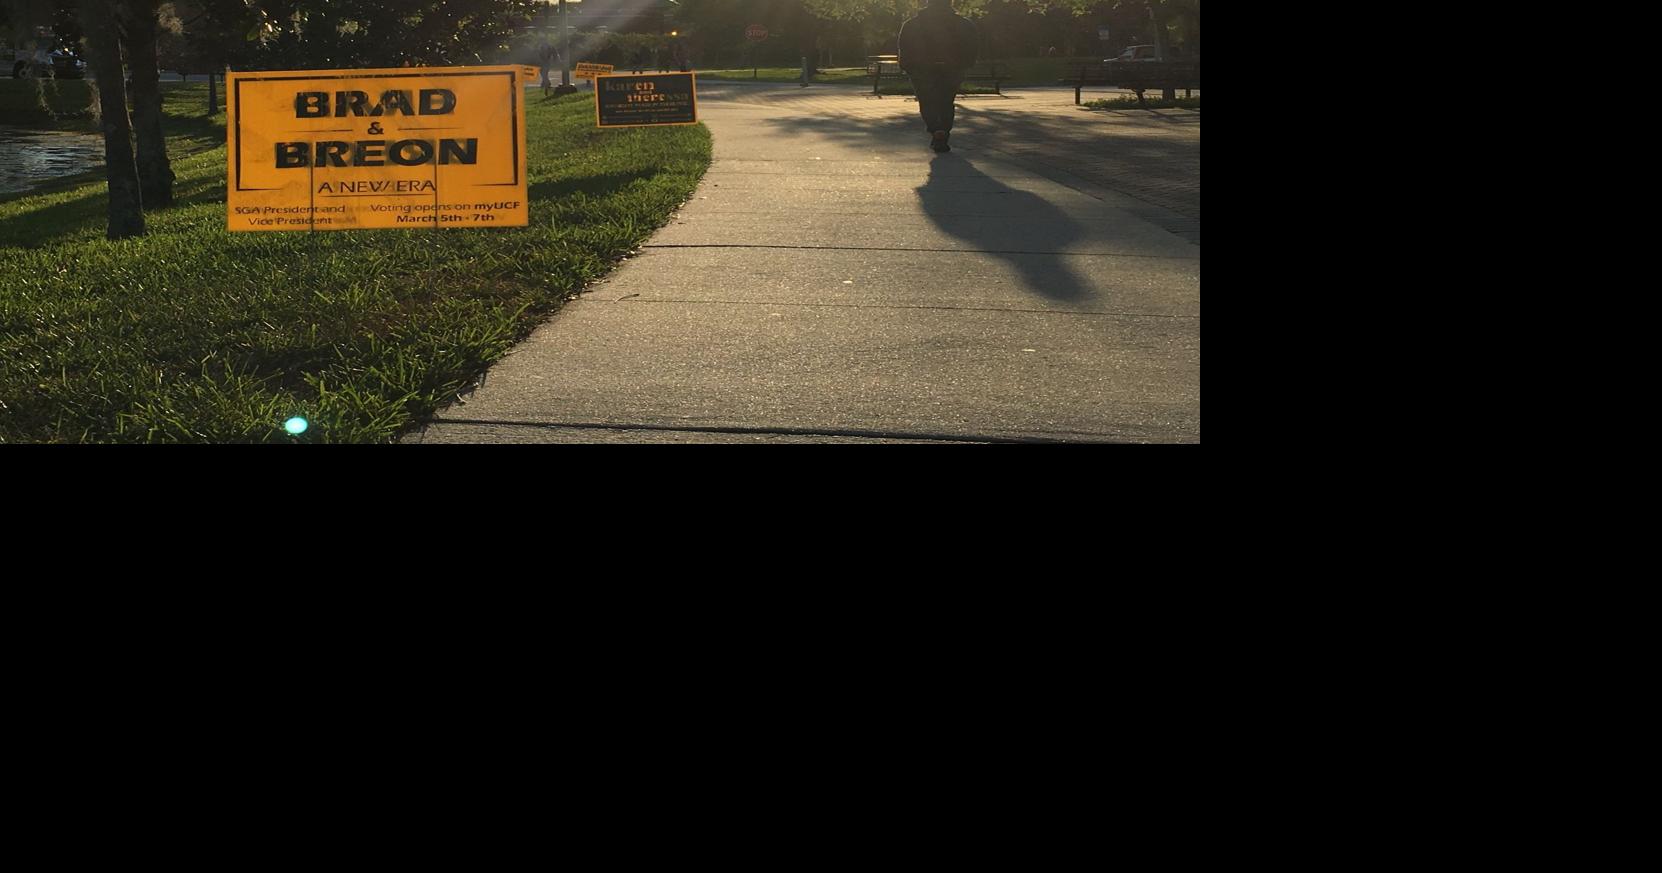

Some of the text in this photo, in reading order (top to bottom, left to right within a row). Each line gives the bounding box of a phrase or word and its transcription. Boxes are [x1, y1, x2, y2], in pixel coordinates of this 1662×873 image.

[295, 88, 457, 118] BRAD
[367, 121, 384, 135] &
[275, 137, 478, 168] BREON
[317, 180, 437, 193] A NEW ERA
[234, 204, 346, 214] SGA President and
[370, 203, 411, 213] Voting
[414, 204, 450, 213] opens
[474, 201, 521, 211] myUCF
[248, 217, 332, 225] Vice President
[396, 215, 437, 223] March
[440, 214, 462, 222] 5th
[472, 213, 494, 221] 7th
